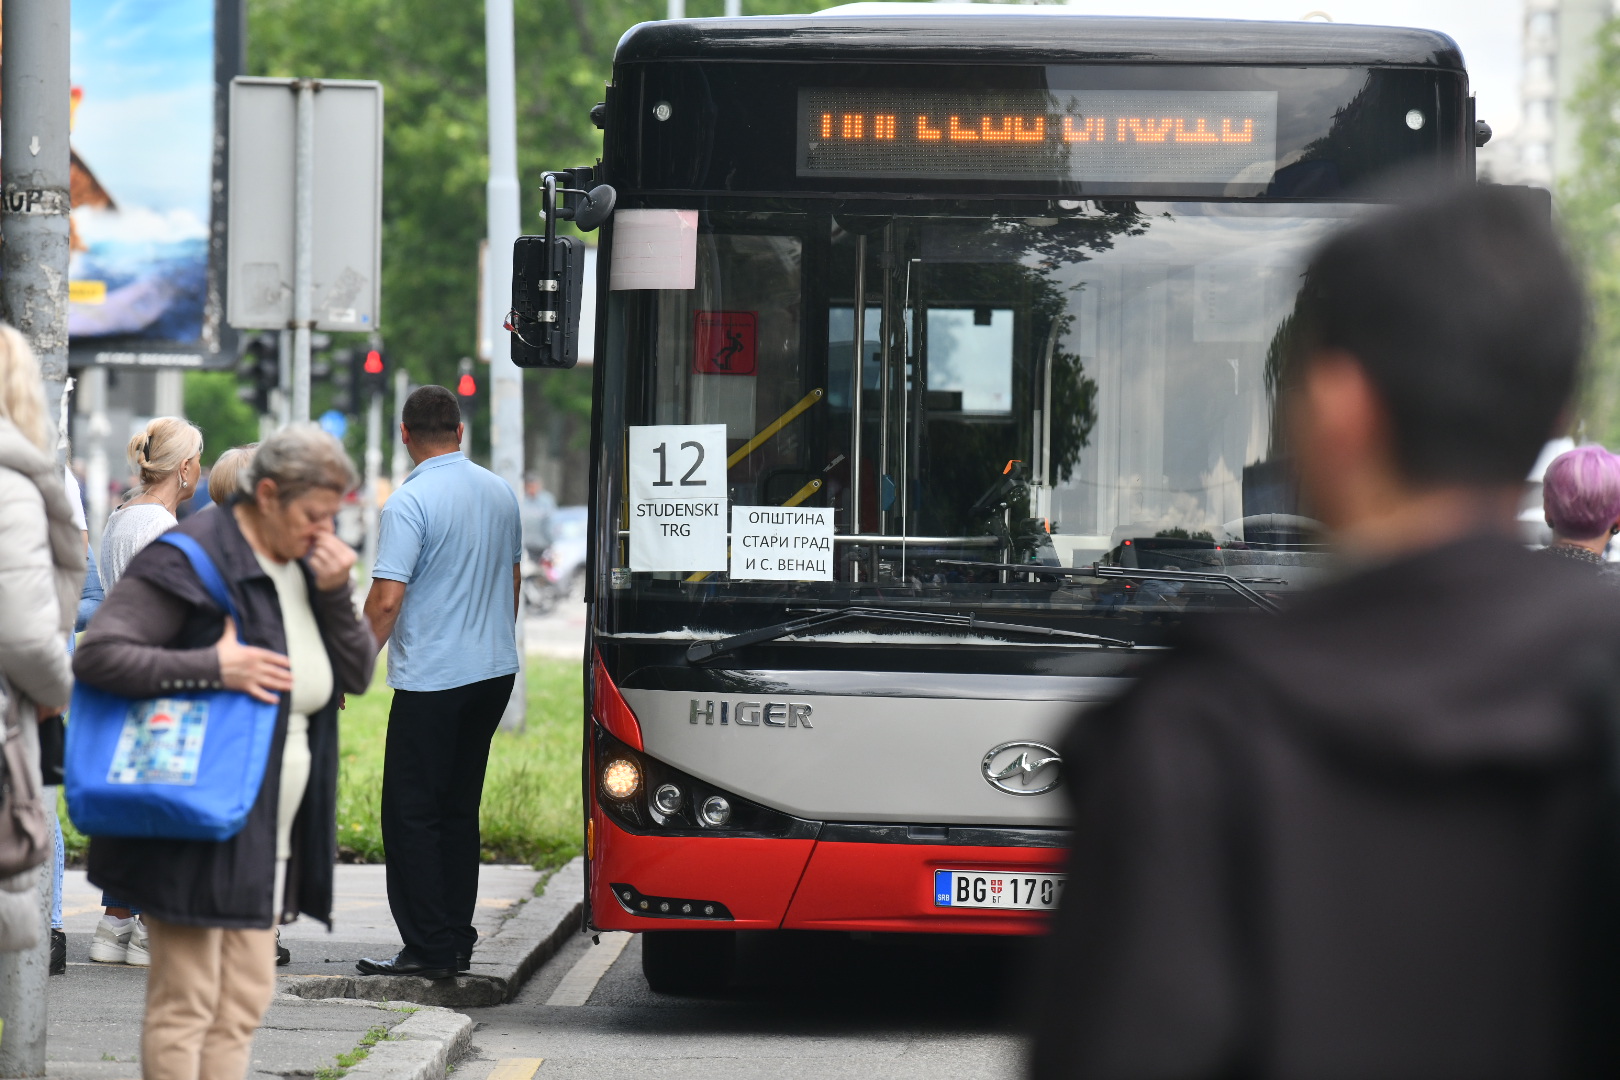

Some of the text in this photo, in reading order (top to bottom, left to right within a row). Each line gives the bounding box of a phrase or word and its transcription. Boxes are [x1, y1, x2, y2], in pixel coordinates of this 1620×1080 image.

[652, 441, 707, 487] 12
[636, 503, 719, 517] STUDENSKI
[749, 511, 825, 525] ОПШТИНА
[660, 523, 691, 537] TRG
[742, 535, 830, 552] СТАРИ ГРАД
[745, 557, 826, 575] И С. ВЕНАЦ
[689, 699, 814, 728] HIGER
[937, 894, 950, 902] SRB
[956, 876, 987, 903] BG
